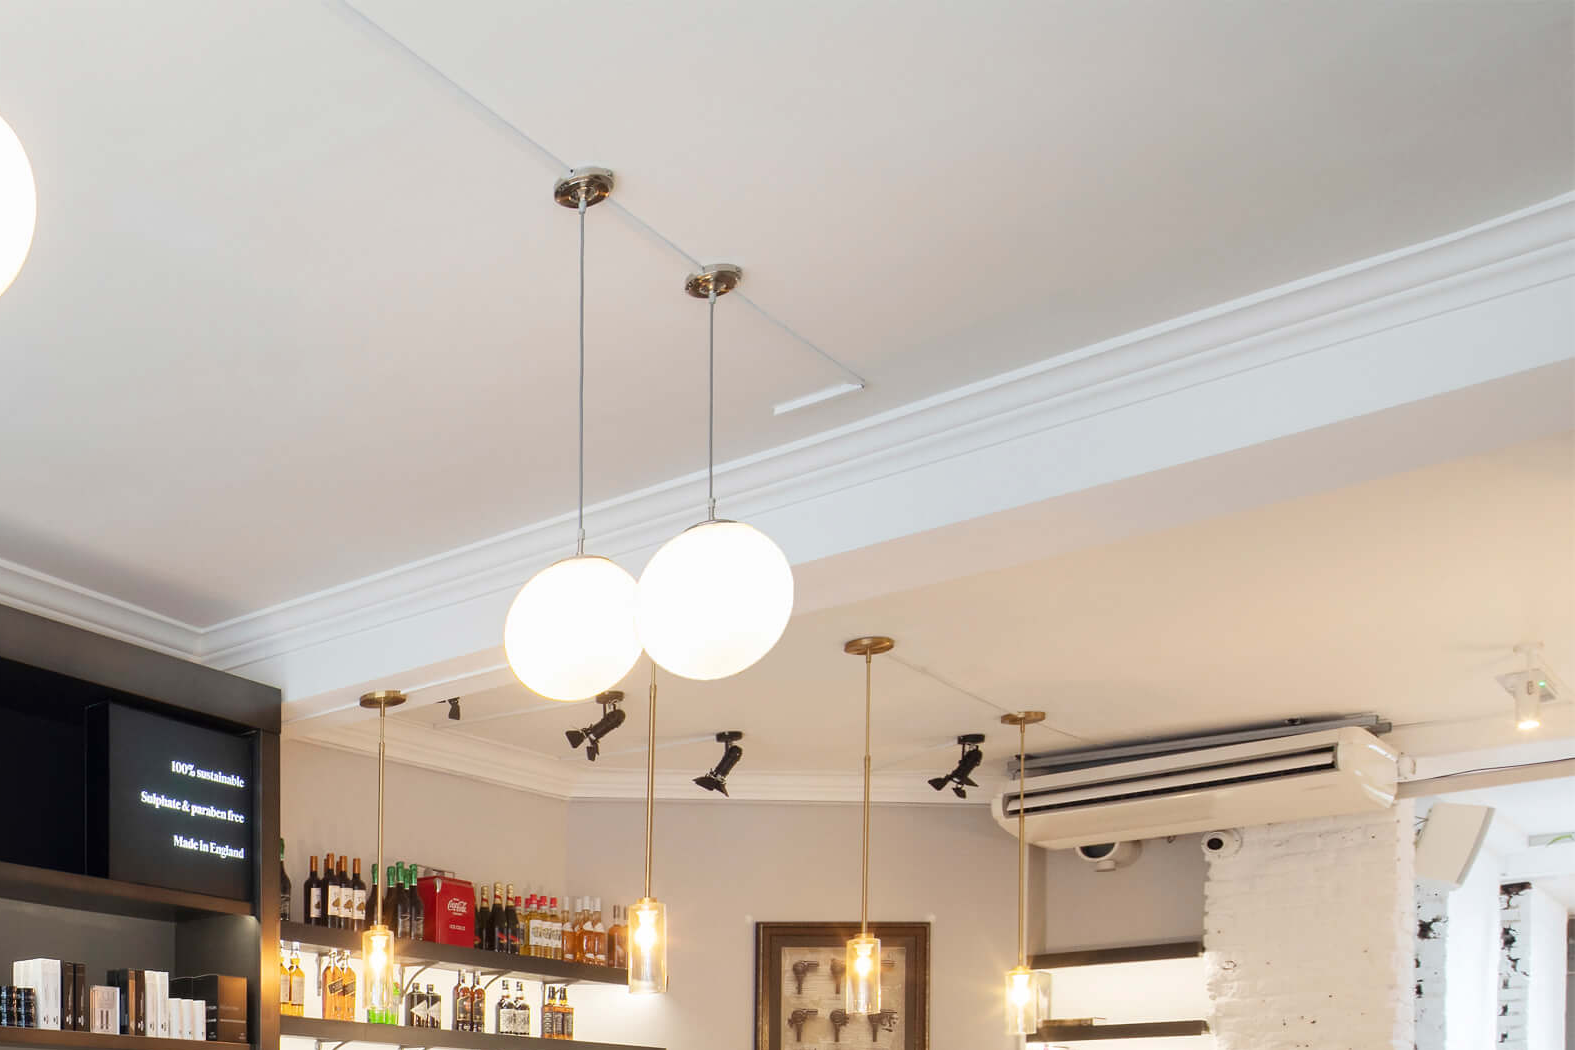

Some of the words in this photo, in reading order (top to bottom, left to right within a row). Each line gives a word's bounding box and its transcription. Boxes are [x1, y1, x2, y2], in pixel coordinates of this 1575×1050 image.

[171, 760, 196, 778] 100%
[197, 769, 245, 788] sustainable
[140, 790, 182, 809] Sulphate
[181, 799, 190, 812] &
[191, 803, 227, 820] paraben
[227, 809, 245, 824] free
[173, 834, 199, 850] Made
[209, 841, 245, 859] England
